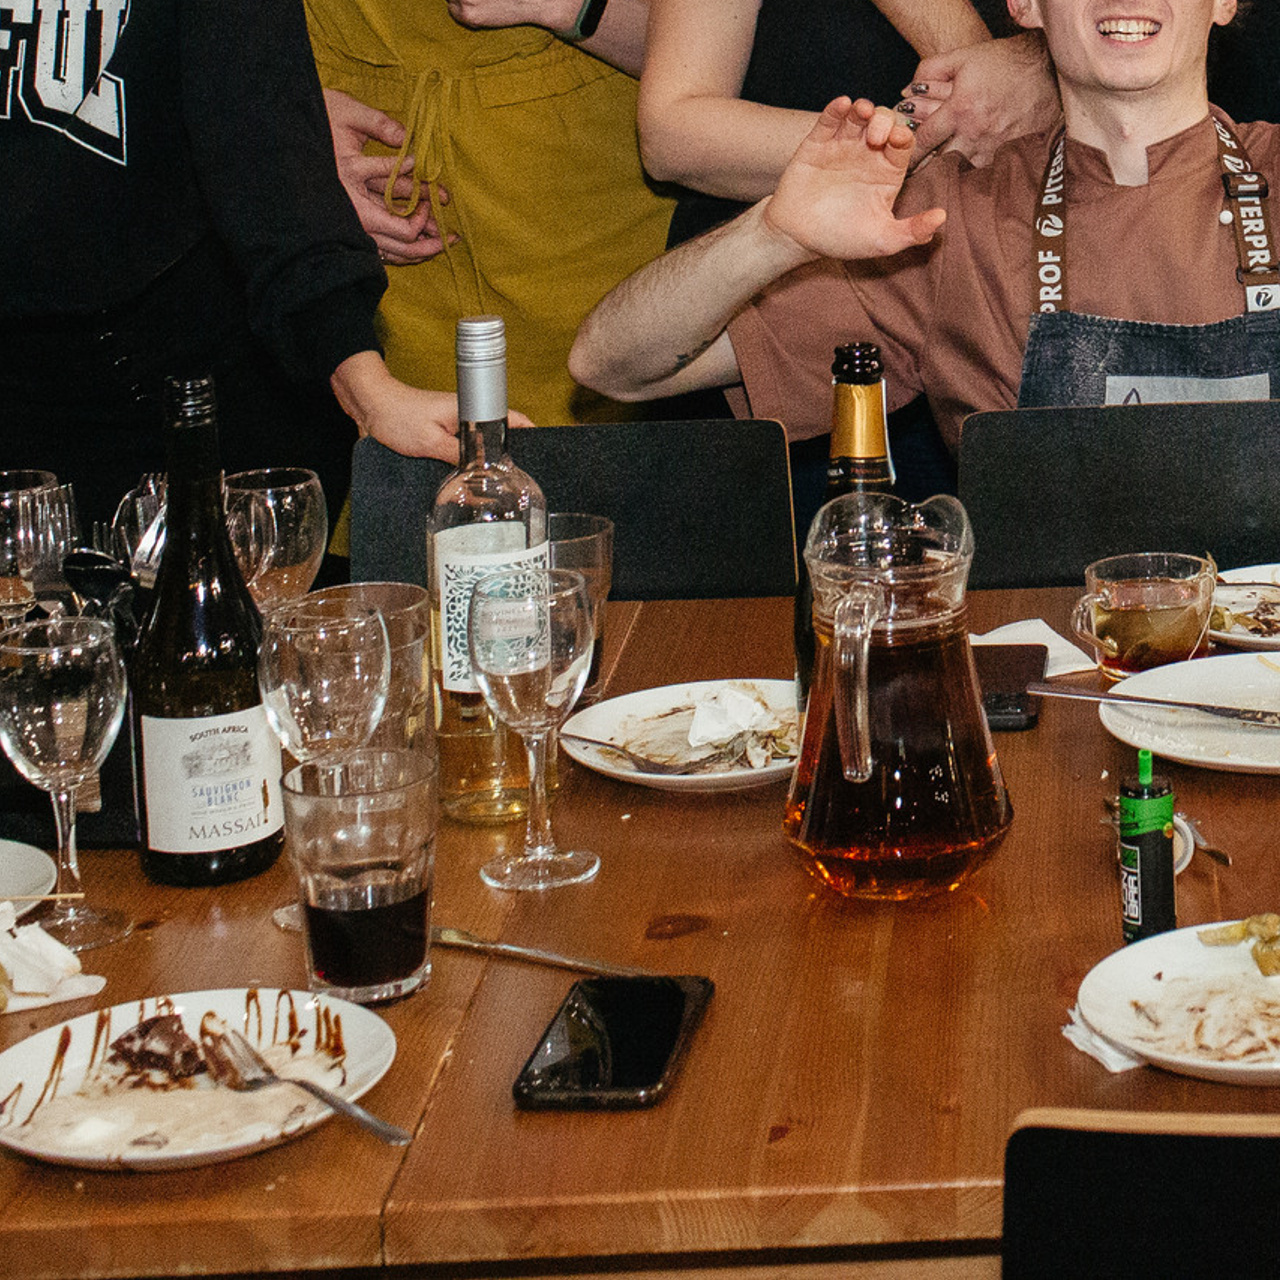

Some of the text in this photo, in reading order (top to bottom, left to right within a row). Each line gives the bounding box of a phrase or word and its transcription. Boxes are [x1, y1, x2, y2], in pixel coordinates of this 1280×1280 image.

[221, 725, 249, 734] AFRICA
[192, 779, 251, 798] SAUVIGNON
[207, 792, 240, 807] BLANC
